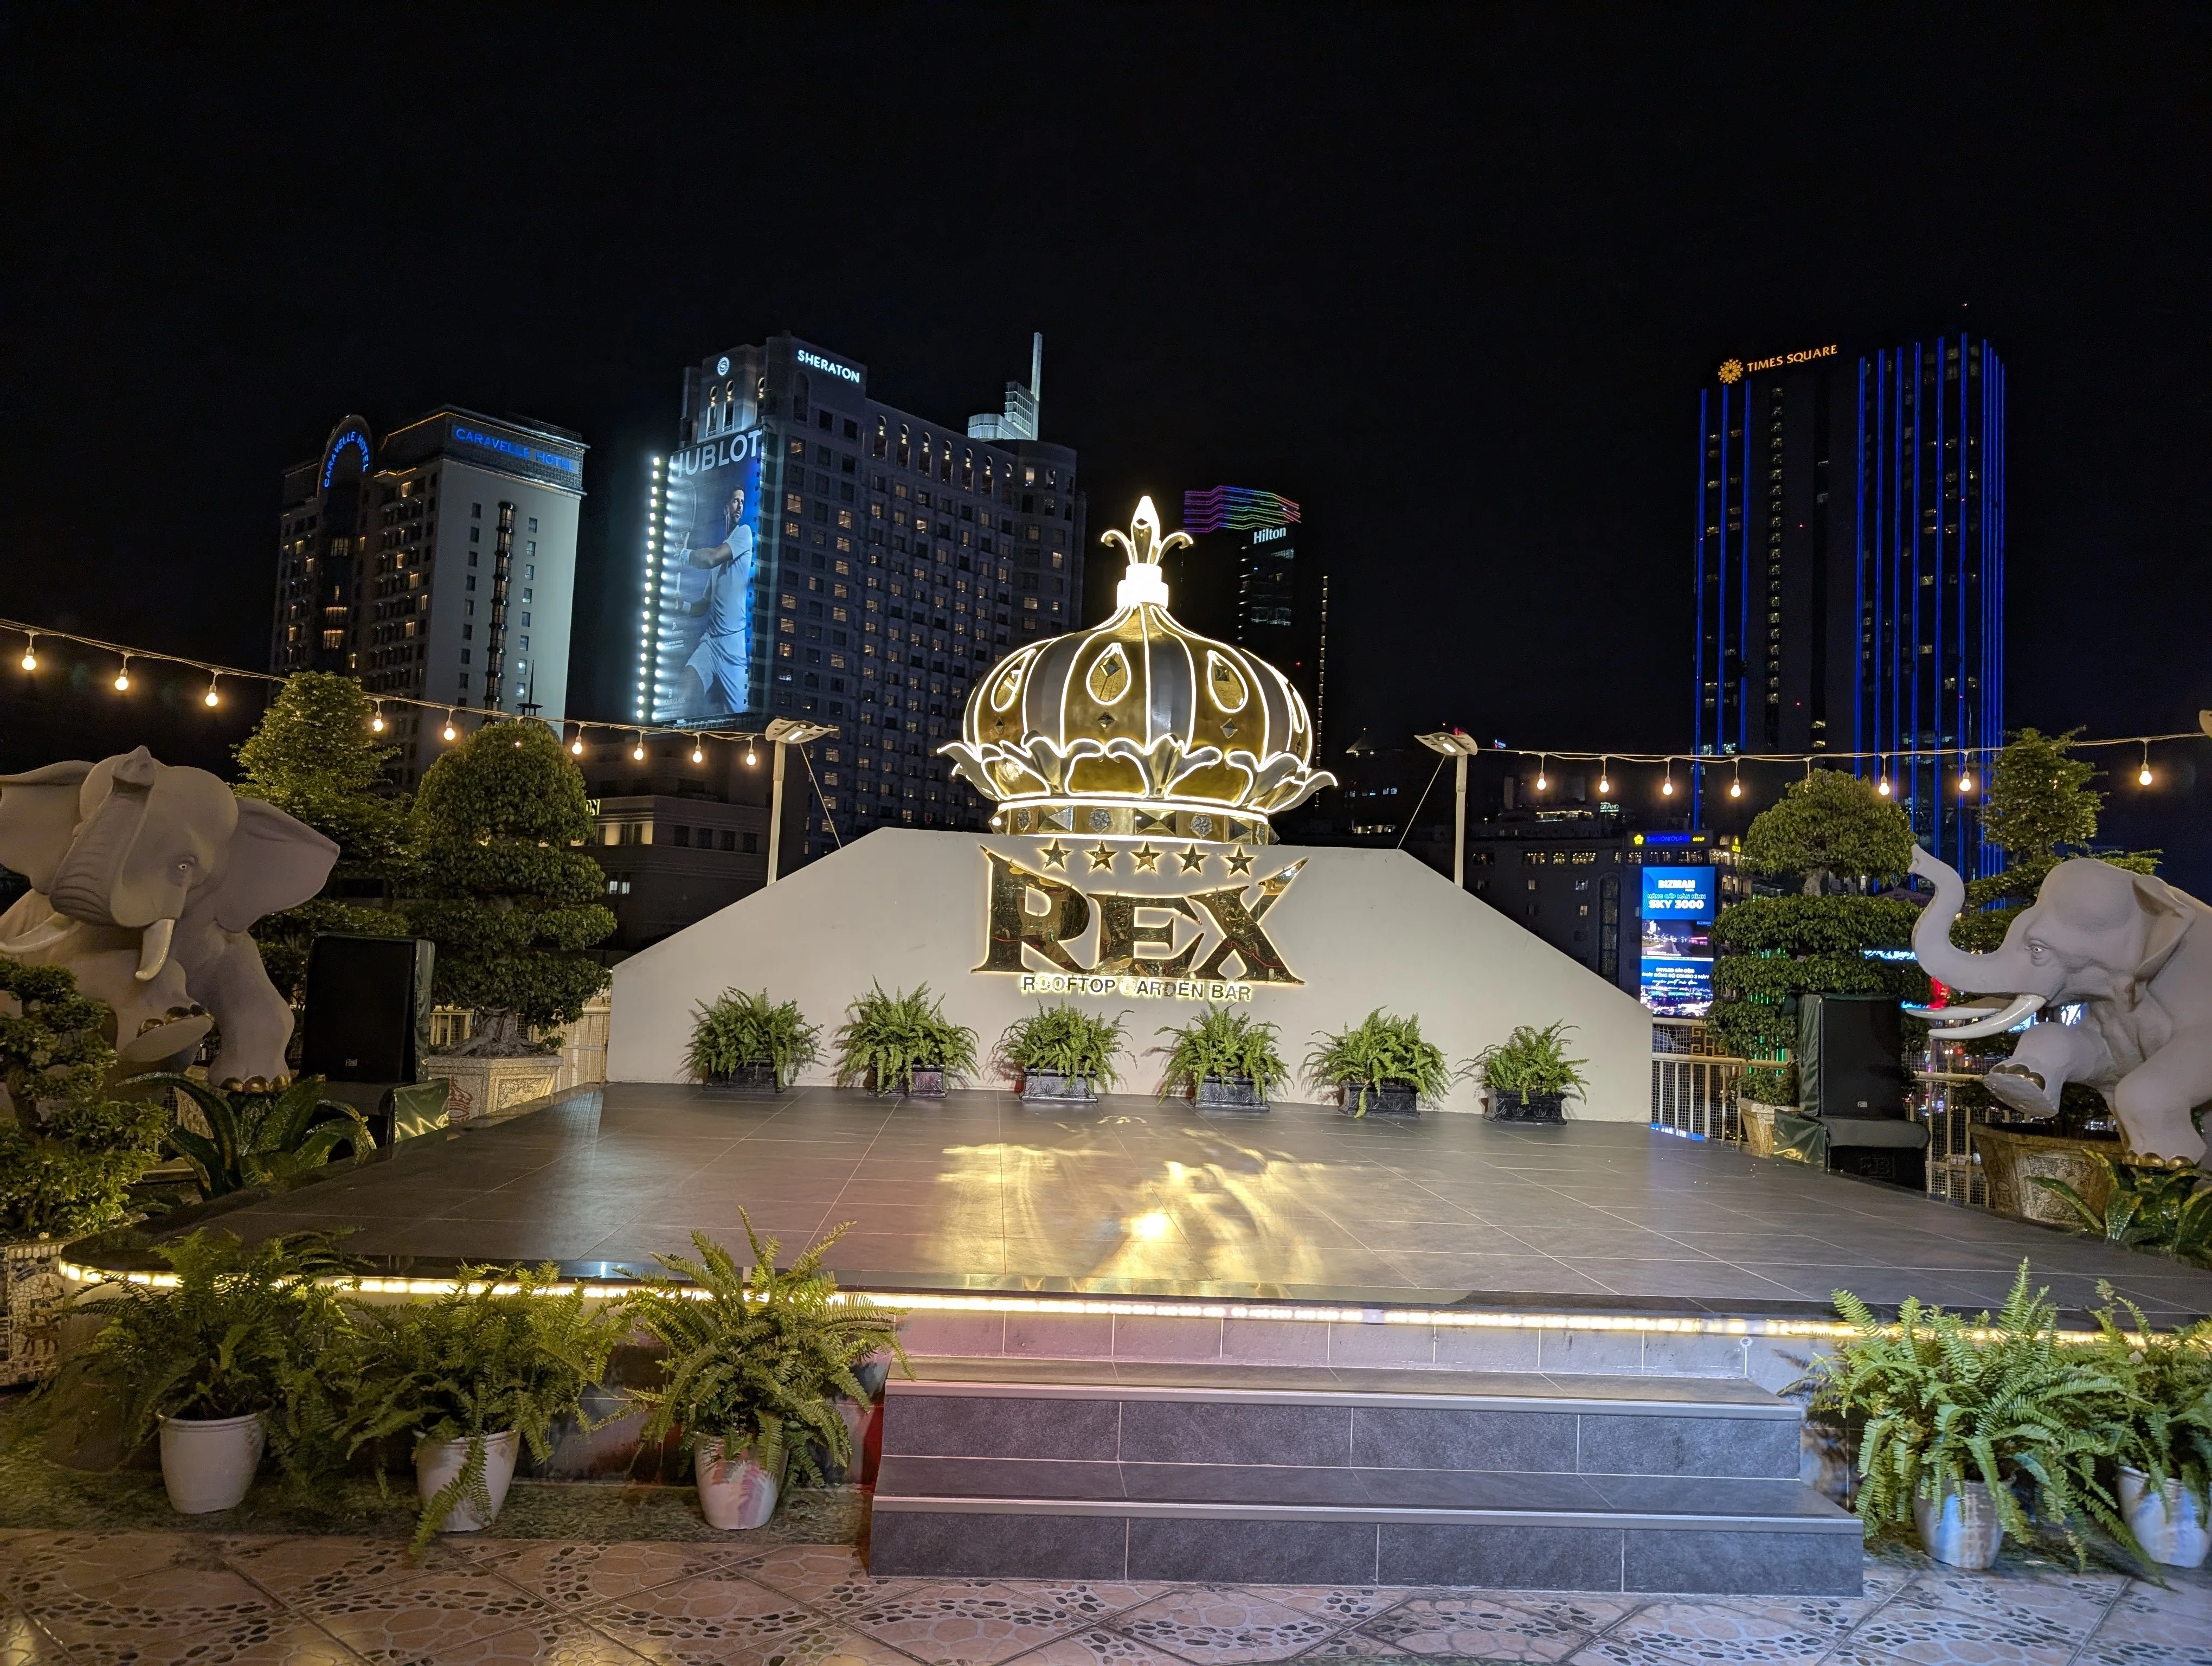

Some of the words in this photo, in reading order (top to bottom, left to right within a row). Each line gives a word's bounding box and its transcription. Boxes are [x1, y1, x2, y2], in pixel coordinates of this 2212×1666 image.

[798, 350, 860, 383] SHERATON
[1747, 356, 1783, 372] TIMES
[1786, 344, 1837, 363] SQUARE
[324, 431, 356, 488] CARAVELLE
[357, 434, 369, 472] HOTEL
[456, 428, 531, 459] CARAVELLE
[536, 451, 576, 471] HOTEL
[668, 429, 762, 478] HUBLOT
[1253, 527, 1287, 544] Hilton
[1658, 880, 1695, 889] BIZMAN
[970, 844, 1310, 985] REX
[1649, 899, 1673, 909] SKY
[1674, 900, 1705, 909] 3000
[1023, 976, 1116, 993] ROOFTOP
[1120, 979, 1204, 998] GARDEN
[1211, 984, 1252, 1001] BAR
